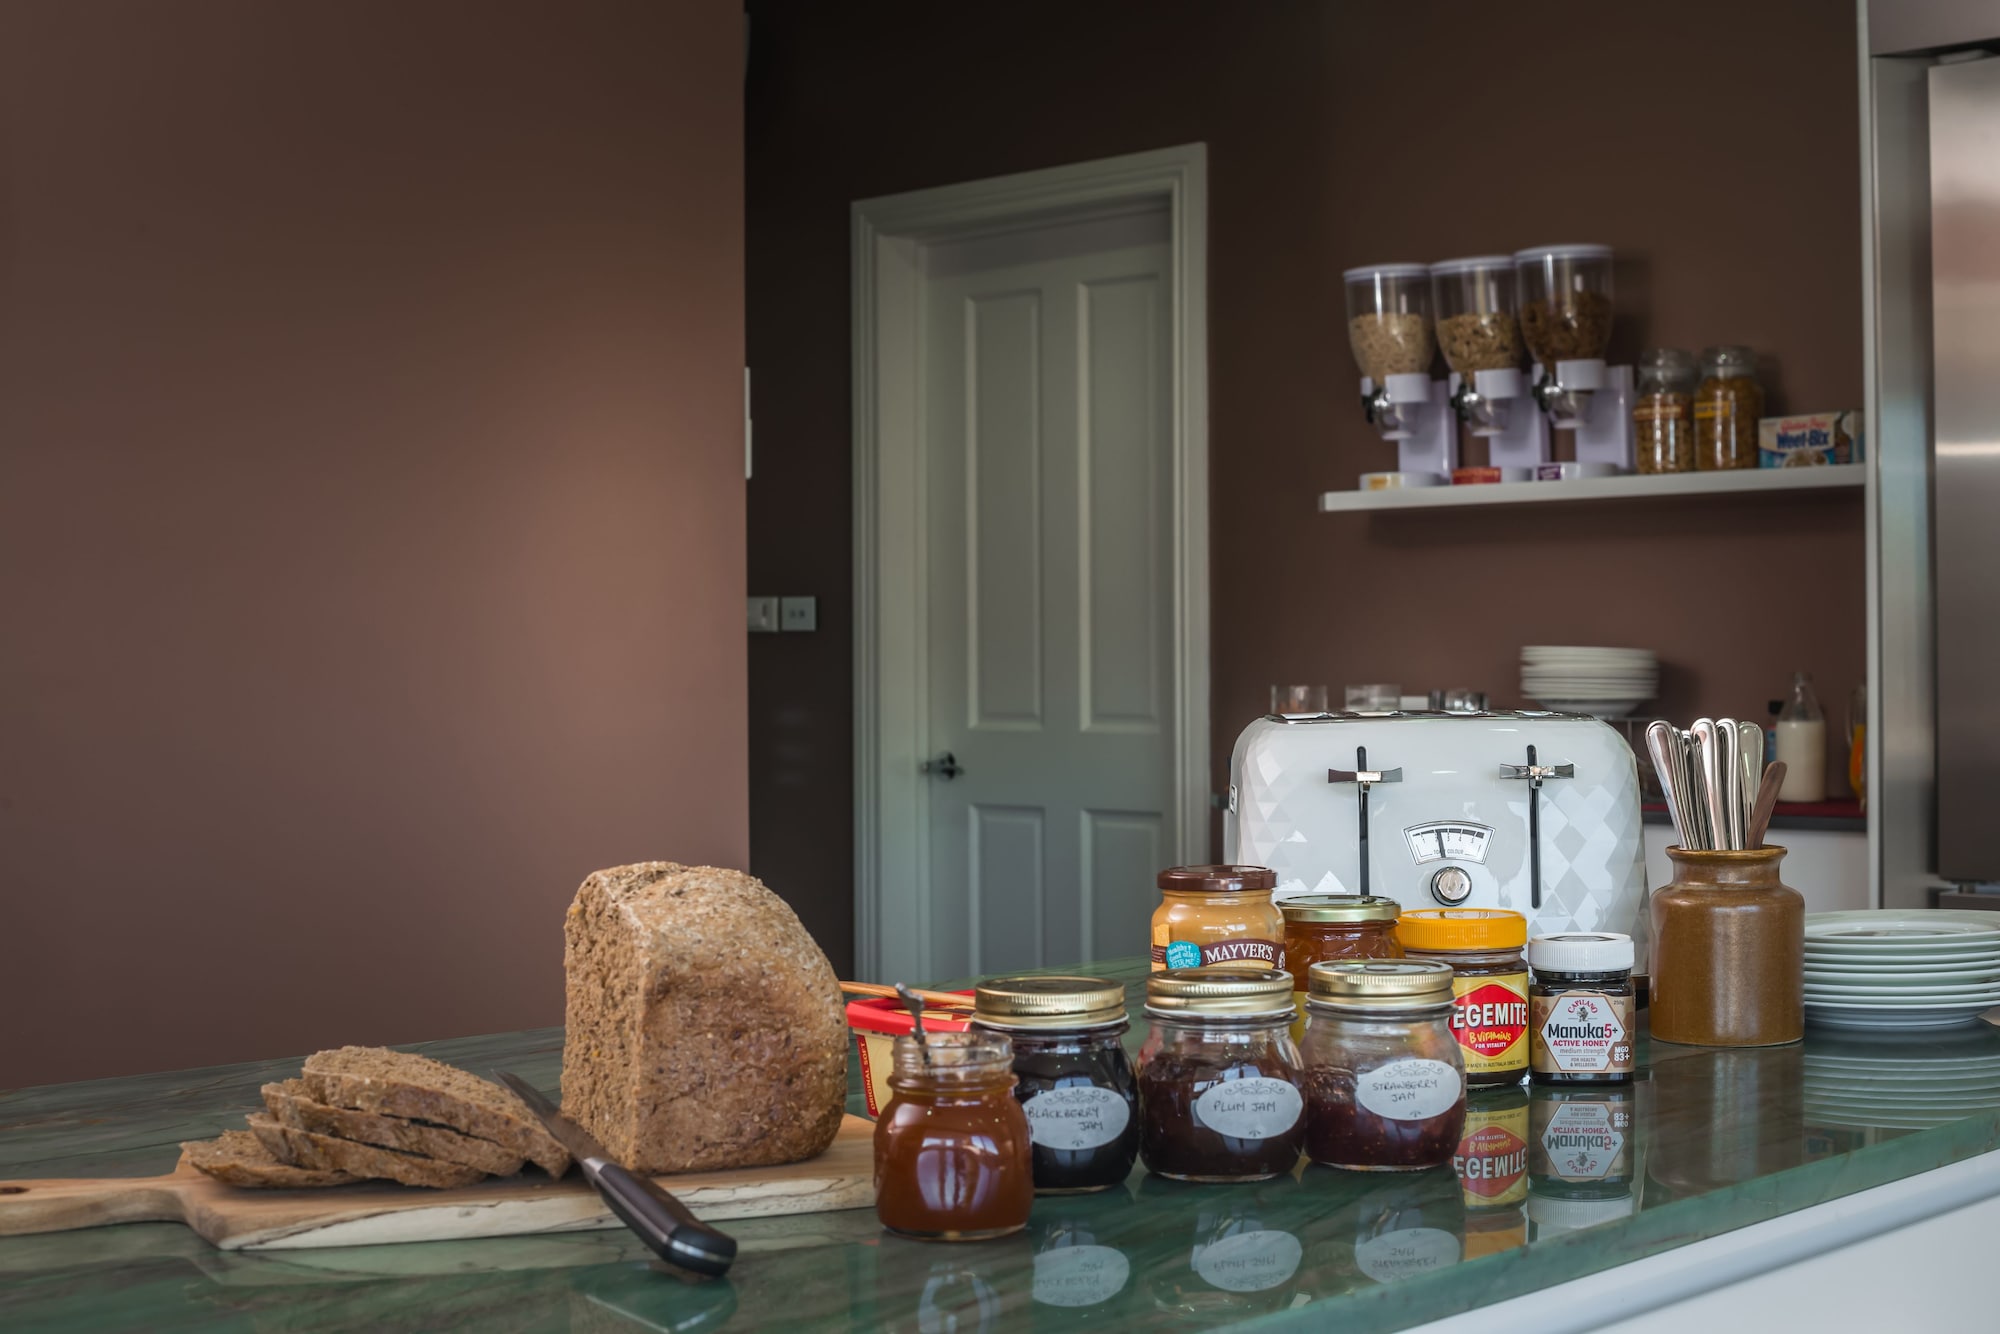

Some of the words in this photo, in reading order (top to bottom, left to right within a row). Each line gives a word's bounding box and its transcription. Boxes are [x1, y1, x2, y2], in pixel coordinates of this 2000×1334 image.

[1205, 943, 1274, 964] MAYVER'S
[1568, 999, 1598, 1014] CAPILANO
[1453, 1002, 1527, 1029] EGEMITE
[859, 1042, 869, 1065] SOFT
[1613, 1053, 1630, 1062] 83+
[864, 1068, 876, 1110] ORIGINAL
[1372, 1079, 1438, 1092] STRAWBERRY
[1391, 1091, 1416, 1103] JAM
[1028, 1106, 1100, 1119] BLACKBERRY
[1213, 1101, 1246, 1113] PLUM
[1251, 1101, 1276, 1113] JAM
[1078, 1120, 1104, 1132] JAM
